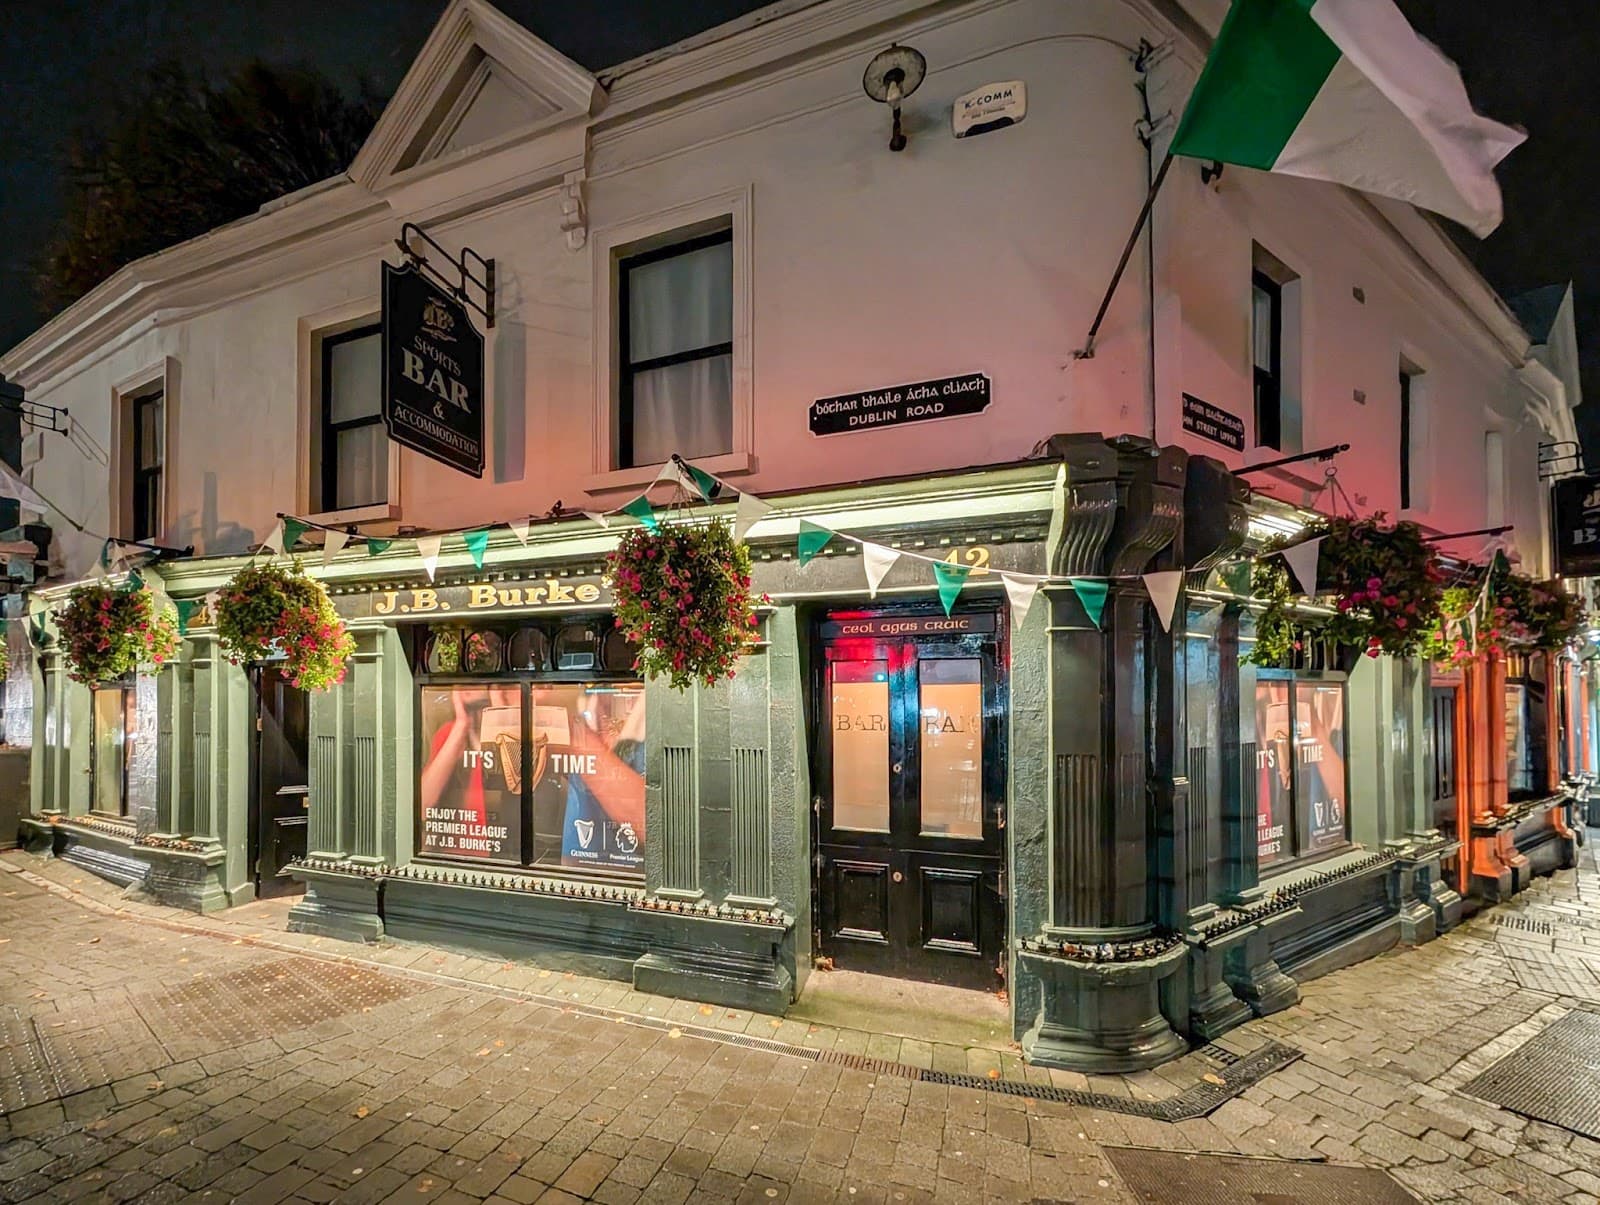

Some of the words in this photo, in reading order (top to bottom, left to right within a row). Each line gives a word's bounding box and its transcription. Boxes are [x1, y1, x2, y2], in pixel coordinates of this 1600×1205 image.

[414, 336, 461, 377] SPORTS
[401, 347, 472, 414] BAR
[432, 401, 445, 420] &
[849, 410, 897, 426] DUBLIN
[906, 402, 944, 417] ROAD
[395, 405, 479, 455] ACCOMMODATION
[942, 546, 990, 577] 42
[375, 588, 451, 614] J.B.
[467, 576, 613, 608] Burke'
[463, 750, 494, 768] IT'S
[551, 754, 597, 774] TIME
[1303, 745, 1323, 763] TIME
[425, 808, 457, 820] ENJOY
[458, 810, 478, 822] THE
[425, 821, 467, 835] PREMIER
[469, 825, 508, 839] LEAGUE
[425, 835, 438, 846] AT
[439, 836, 457, 848] J.B.
[459, 838, 501, 853] BURKE'S
